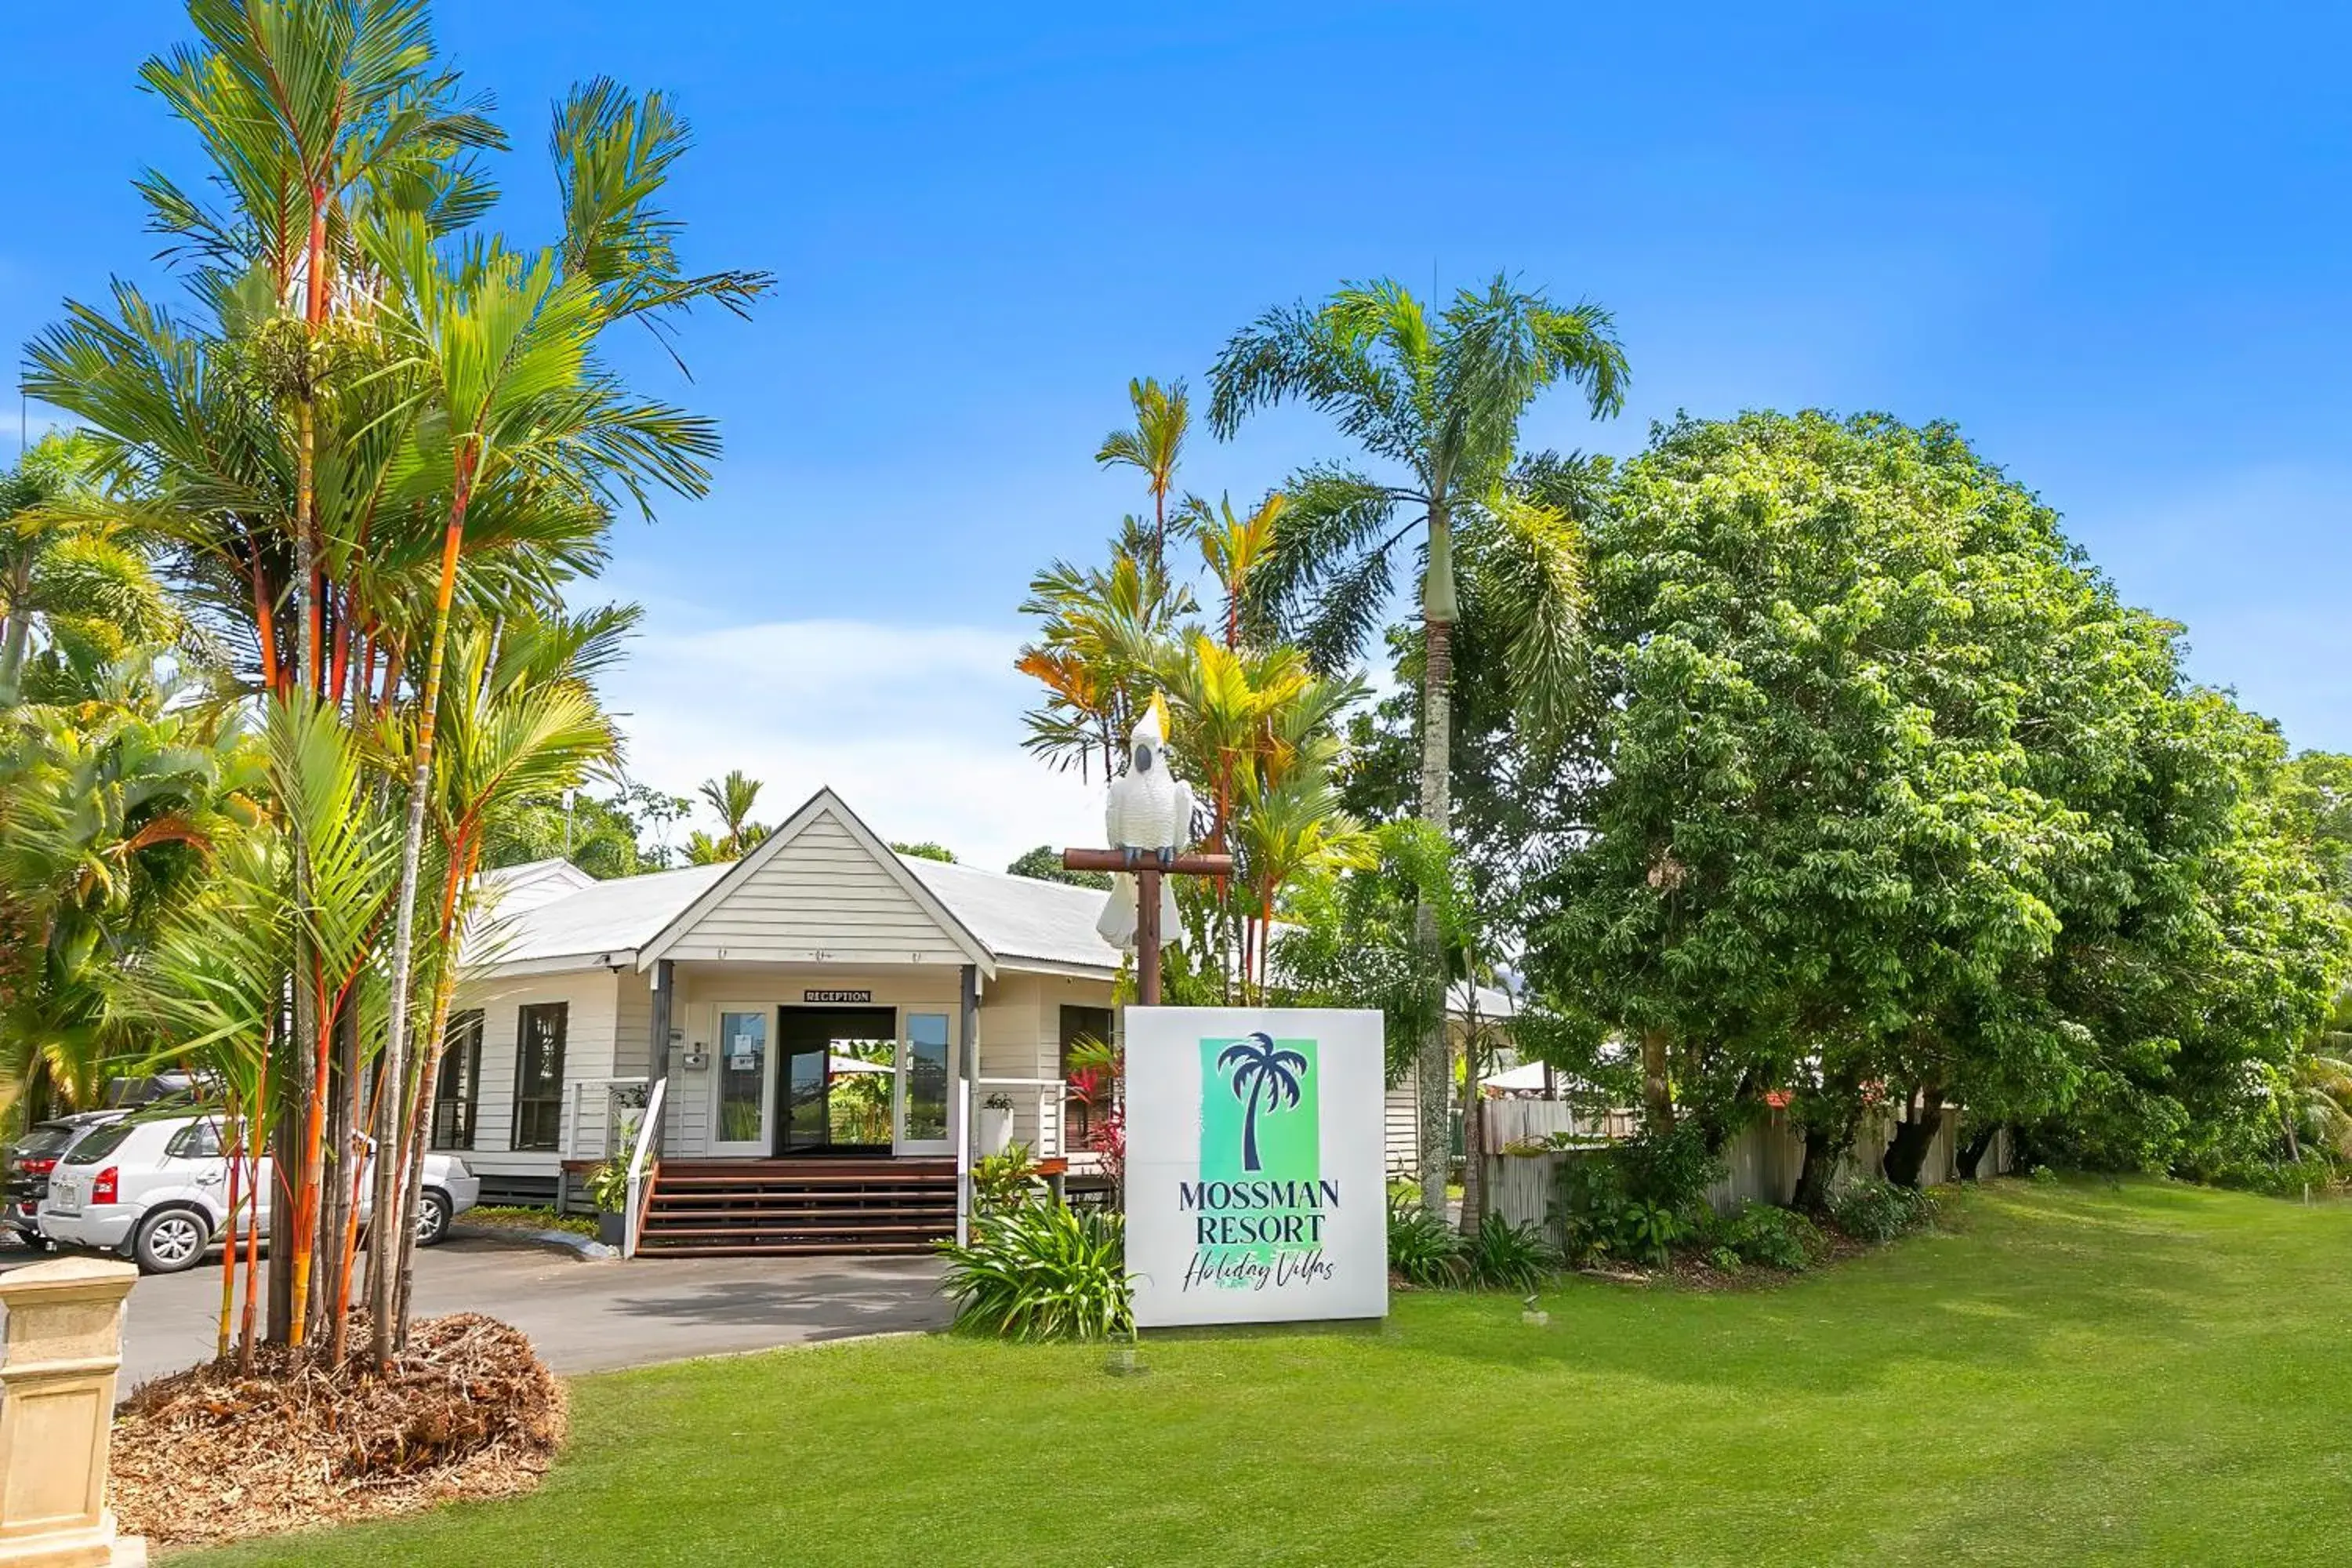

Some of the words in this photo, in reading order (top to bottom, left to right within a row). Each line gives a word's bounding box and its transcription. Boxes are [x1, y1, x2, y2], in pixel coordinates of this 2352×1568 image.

[807, 992, 869, 1001] RECEPTION
[1179, 1179, 1339, 1210] MOSSMAN
[1196, 1214, 1326, 1244] RESORT
[1183, 1250, 1270, 1292] Holiday
[1276, 1248, 1334, 1287] Villas
